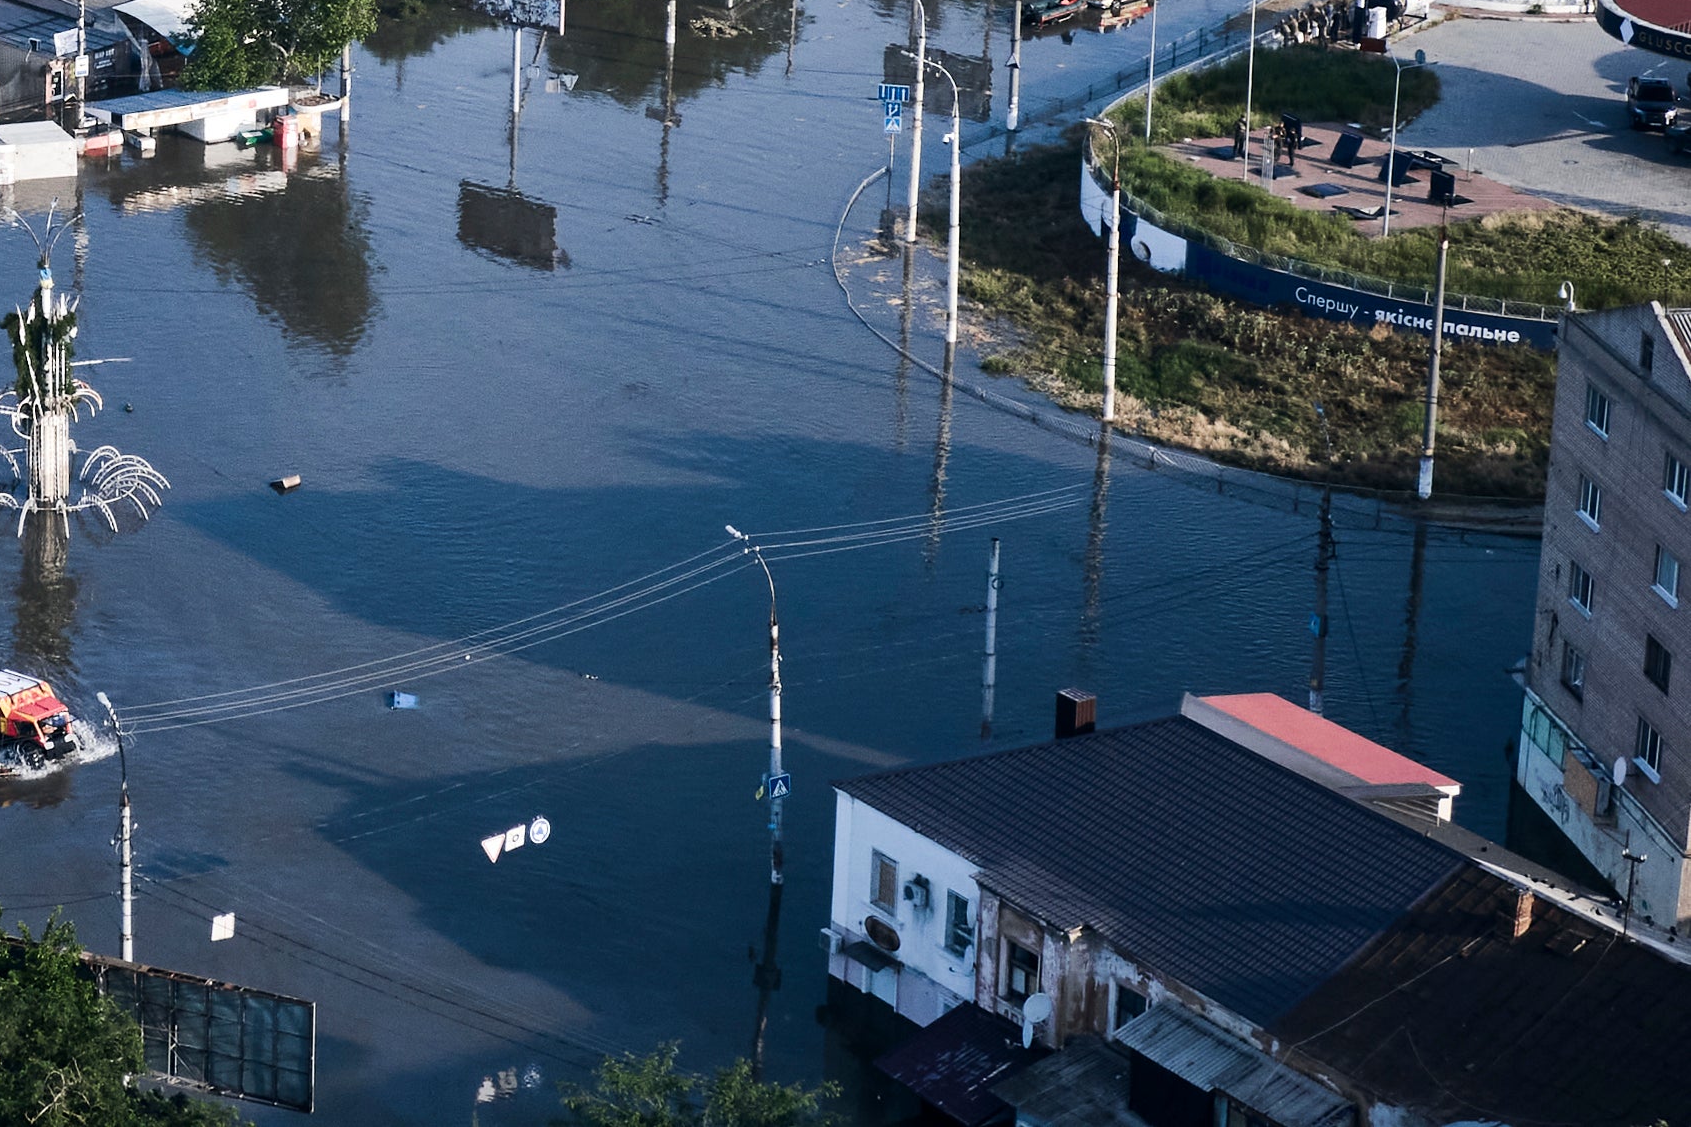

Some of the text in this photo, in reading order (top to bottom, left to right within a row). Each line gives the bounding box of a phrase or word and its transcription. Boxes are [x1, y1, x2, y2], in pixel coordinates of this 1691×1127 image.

[1638, 31, 1691, 56] GLUSCO
[1295, 286, 1359, 319] Спершу
[1374, 308, 1434, 330] якісне
[1442, 321, 1521, 343] пальне
